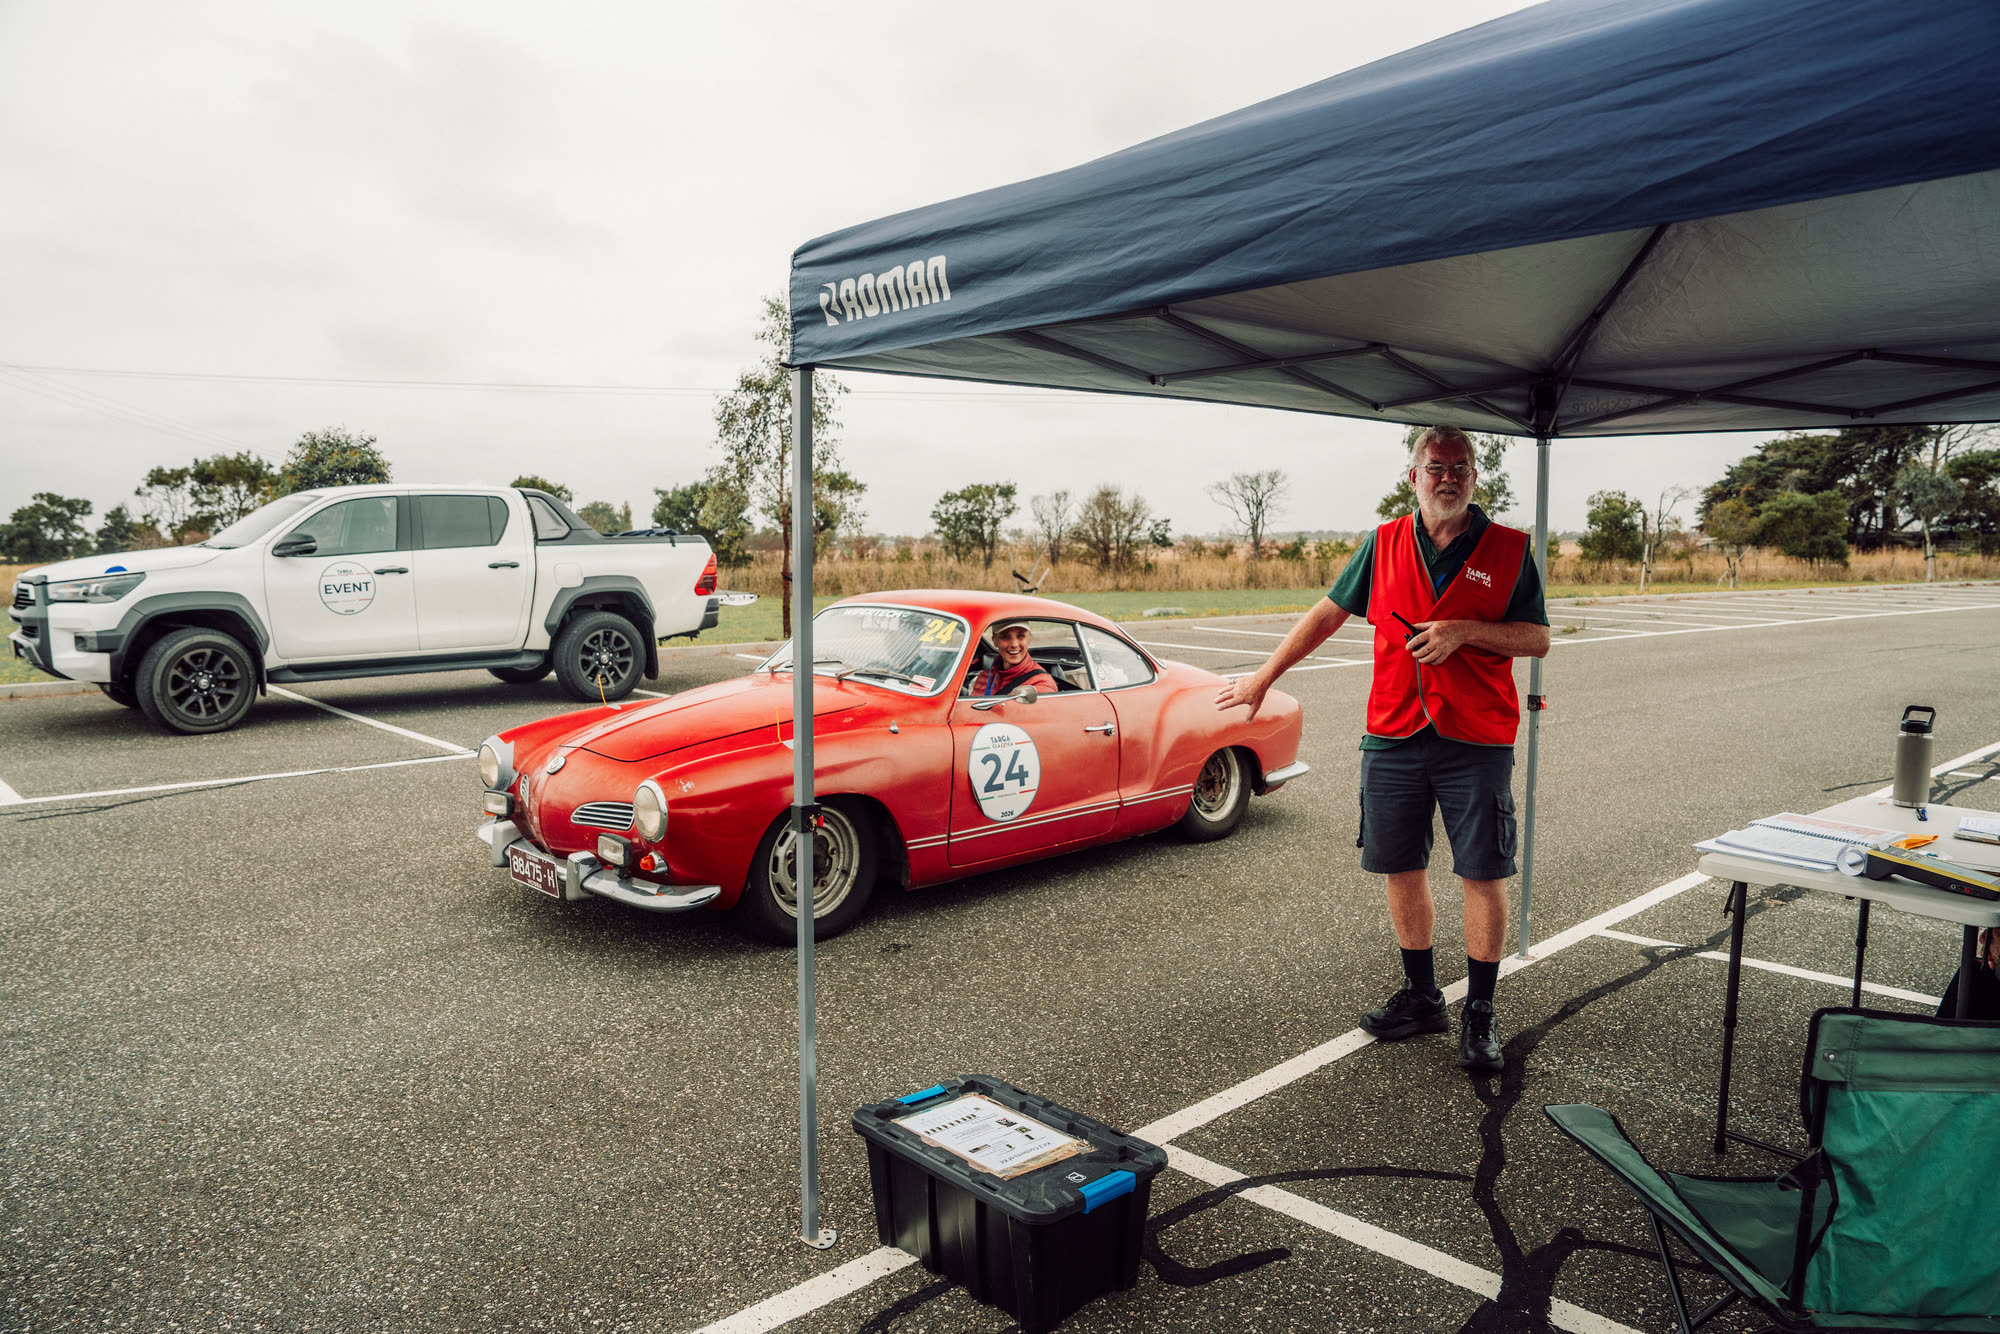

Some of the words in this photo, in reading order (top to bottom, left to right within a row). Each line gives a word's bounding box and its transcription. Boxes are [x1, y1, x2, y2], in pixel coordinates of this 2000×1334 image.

[1467, 566, 1491, 582] TARGA
[324, 581, 371, 595] EVENT
[919, 619, 959, 645] 24
[990, 735, 1011, 744] TARGA
[980, 749, 1029, 794] 24
[1001, 810, 1014, 818] 2026
